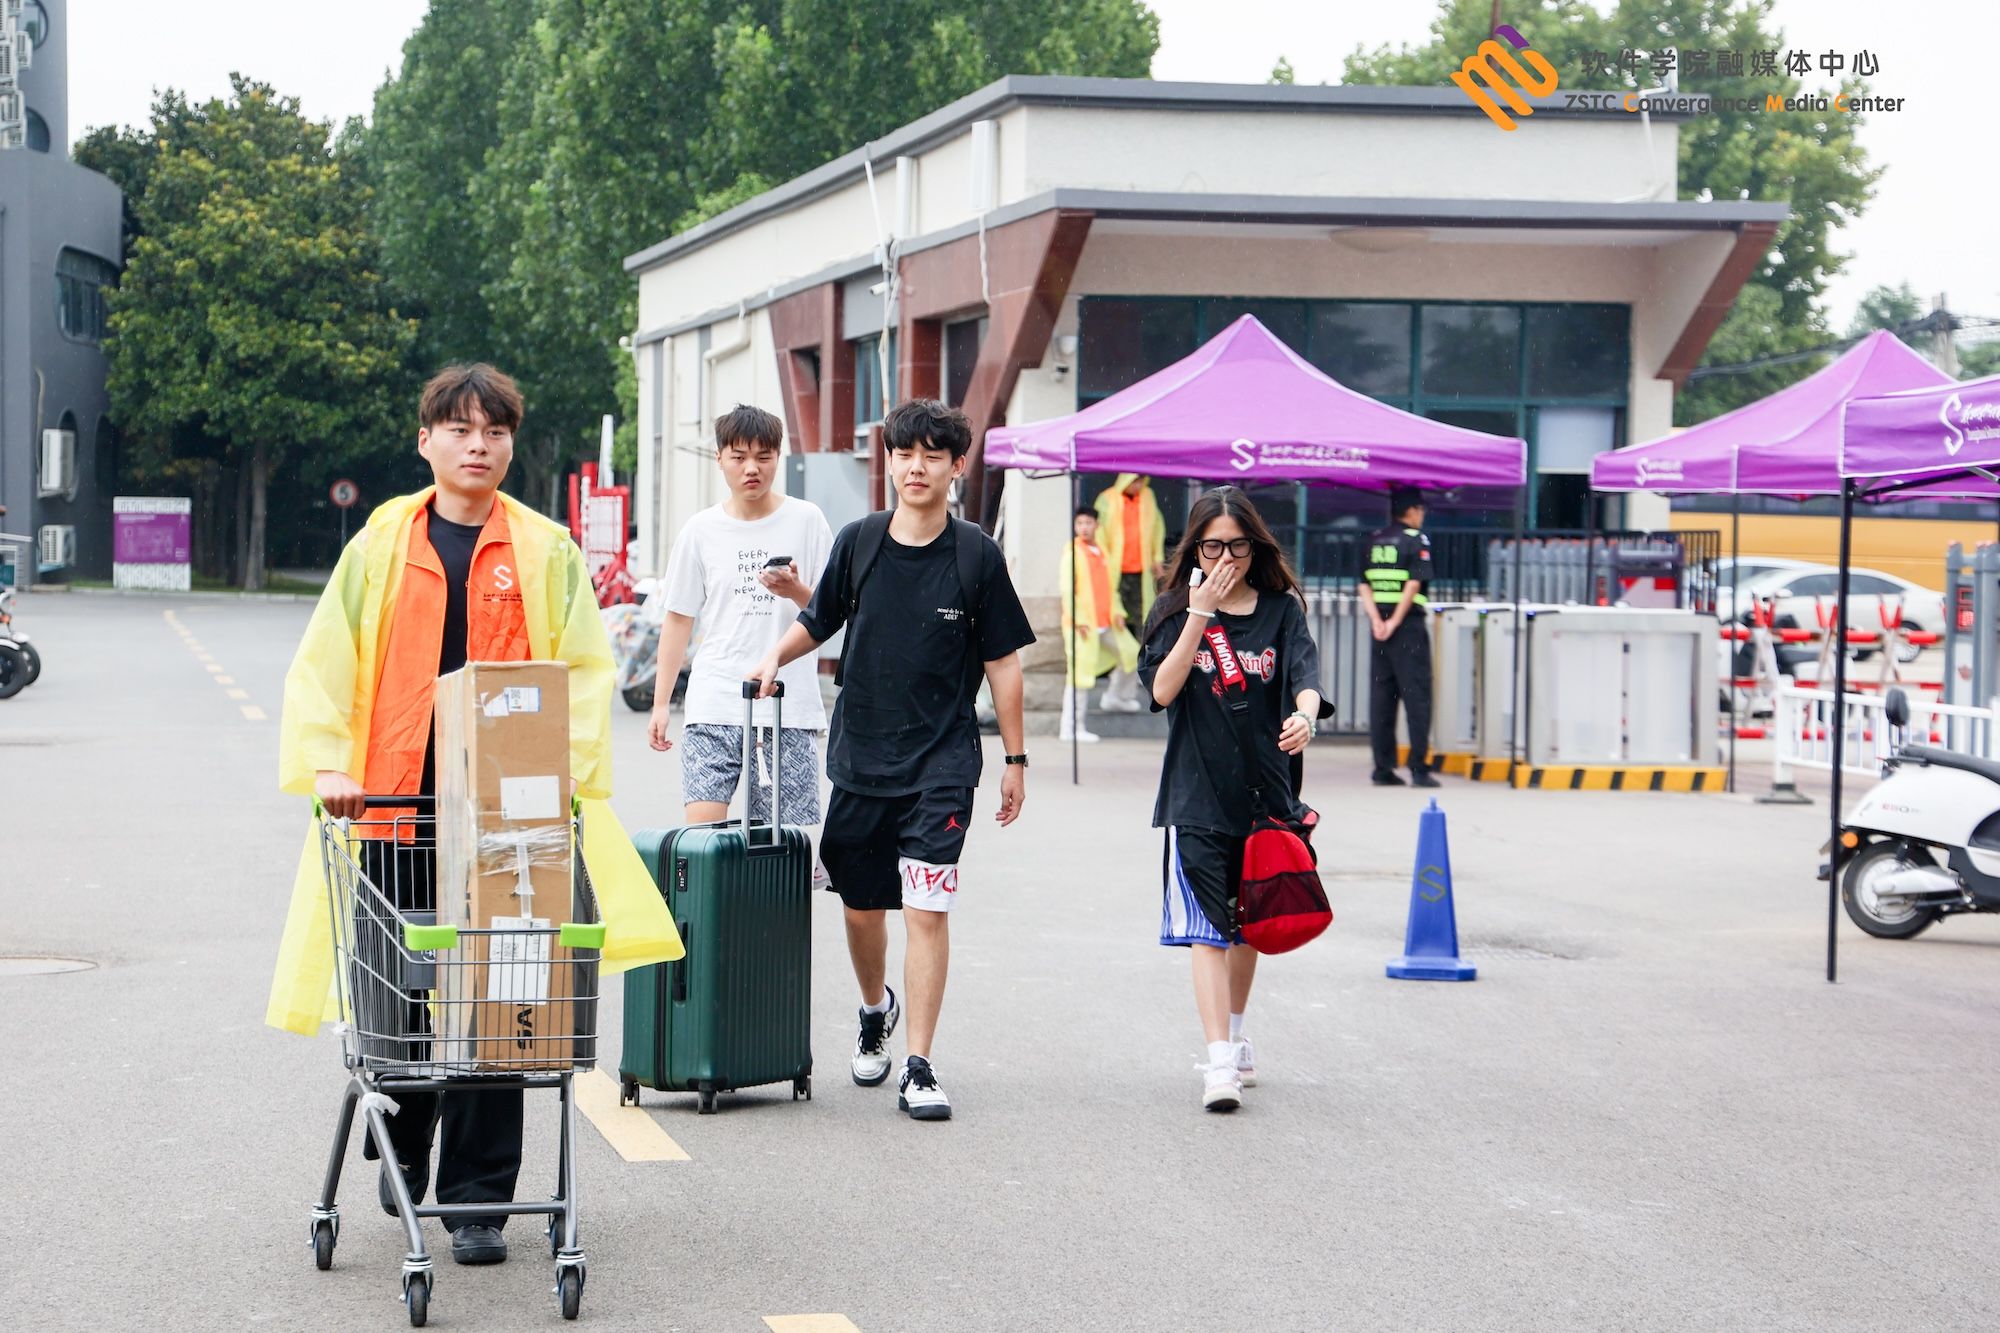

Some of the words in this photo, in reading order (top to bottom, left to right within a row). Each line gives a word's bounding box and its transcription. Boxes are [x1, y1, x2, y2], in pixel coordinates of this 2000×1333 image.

[738, 549, 768, 560] EVERY
[738, 562, 762, 573] PERS
[734, 586, 756, 595] NEW
[751, 593, 776, 603] YORK
[1206, 631, 1239, 680] YOUMAI
